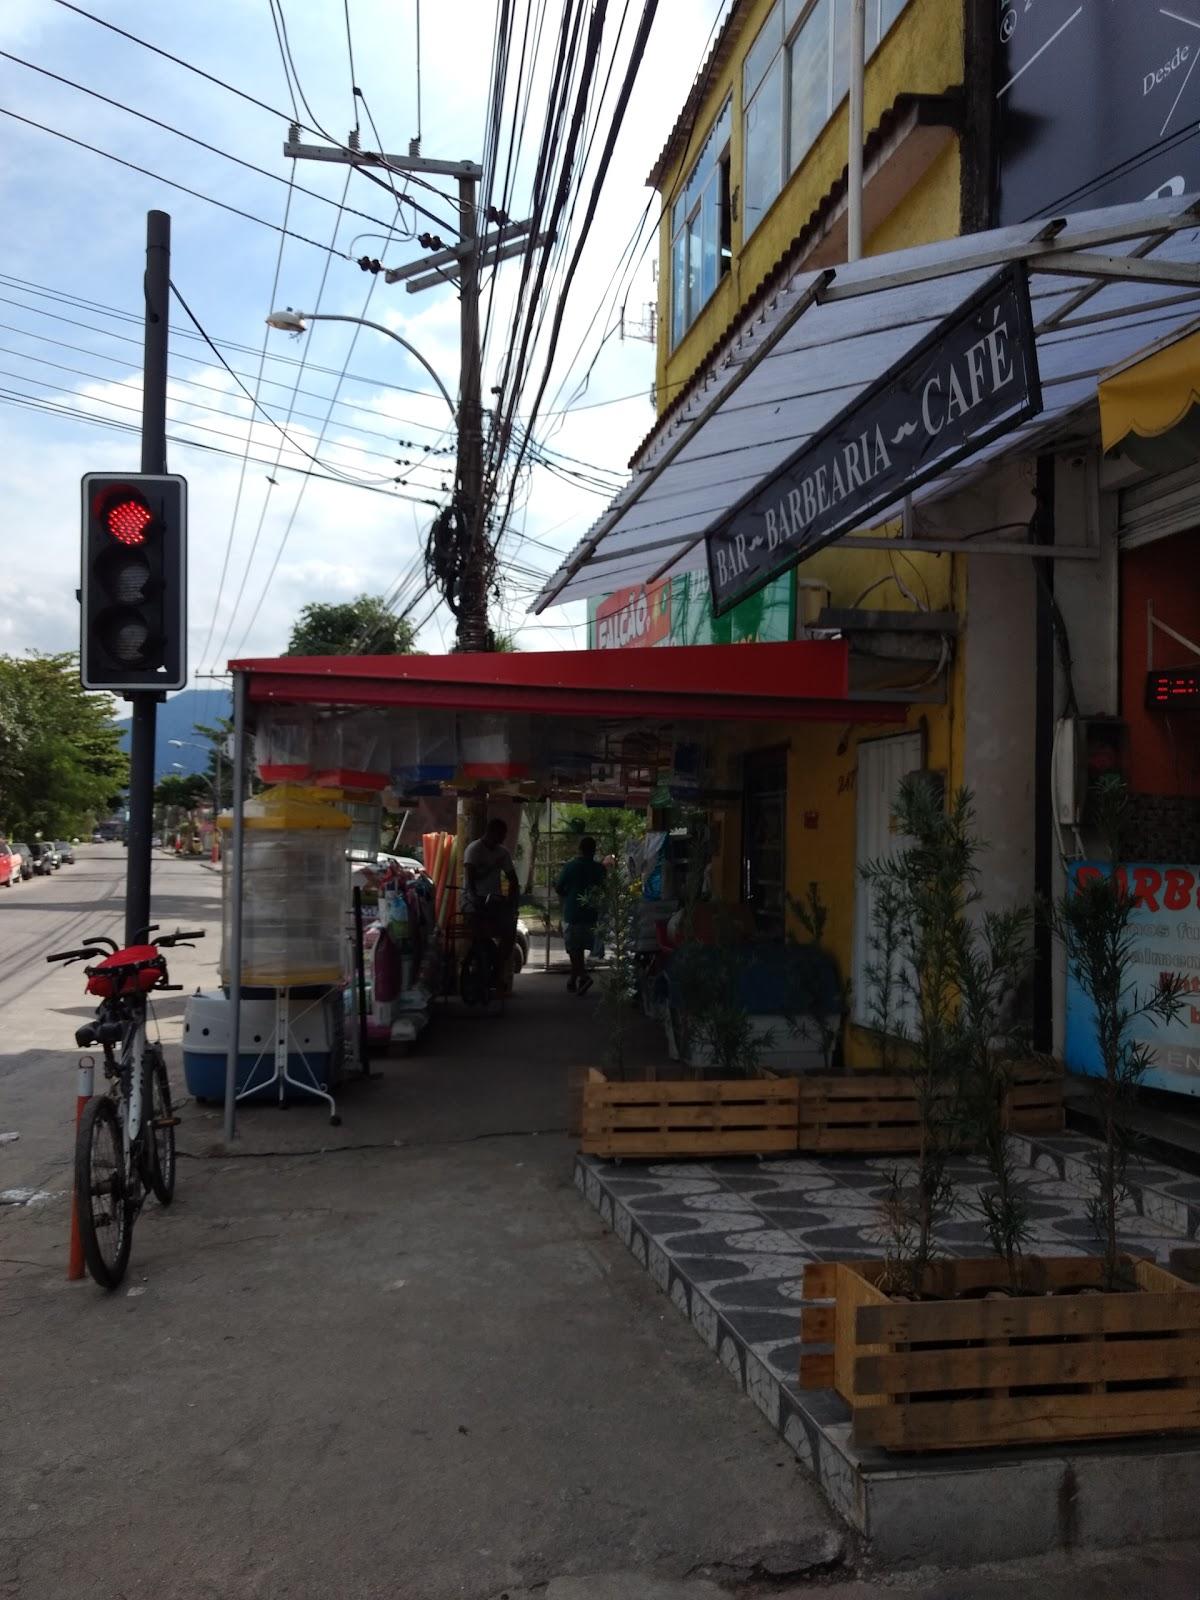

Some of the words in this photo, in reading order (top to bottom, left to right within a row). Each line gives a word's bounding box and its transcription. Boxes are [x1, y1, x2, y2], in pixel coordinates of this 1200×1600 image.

[1142, 45, 1190, 96] Desde
[716, 533, 749, 587] BAR
[764, 423, 892, 552] BARBEARIA
[921, 306, 1014, 436] CAFÉ
